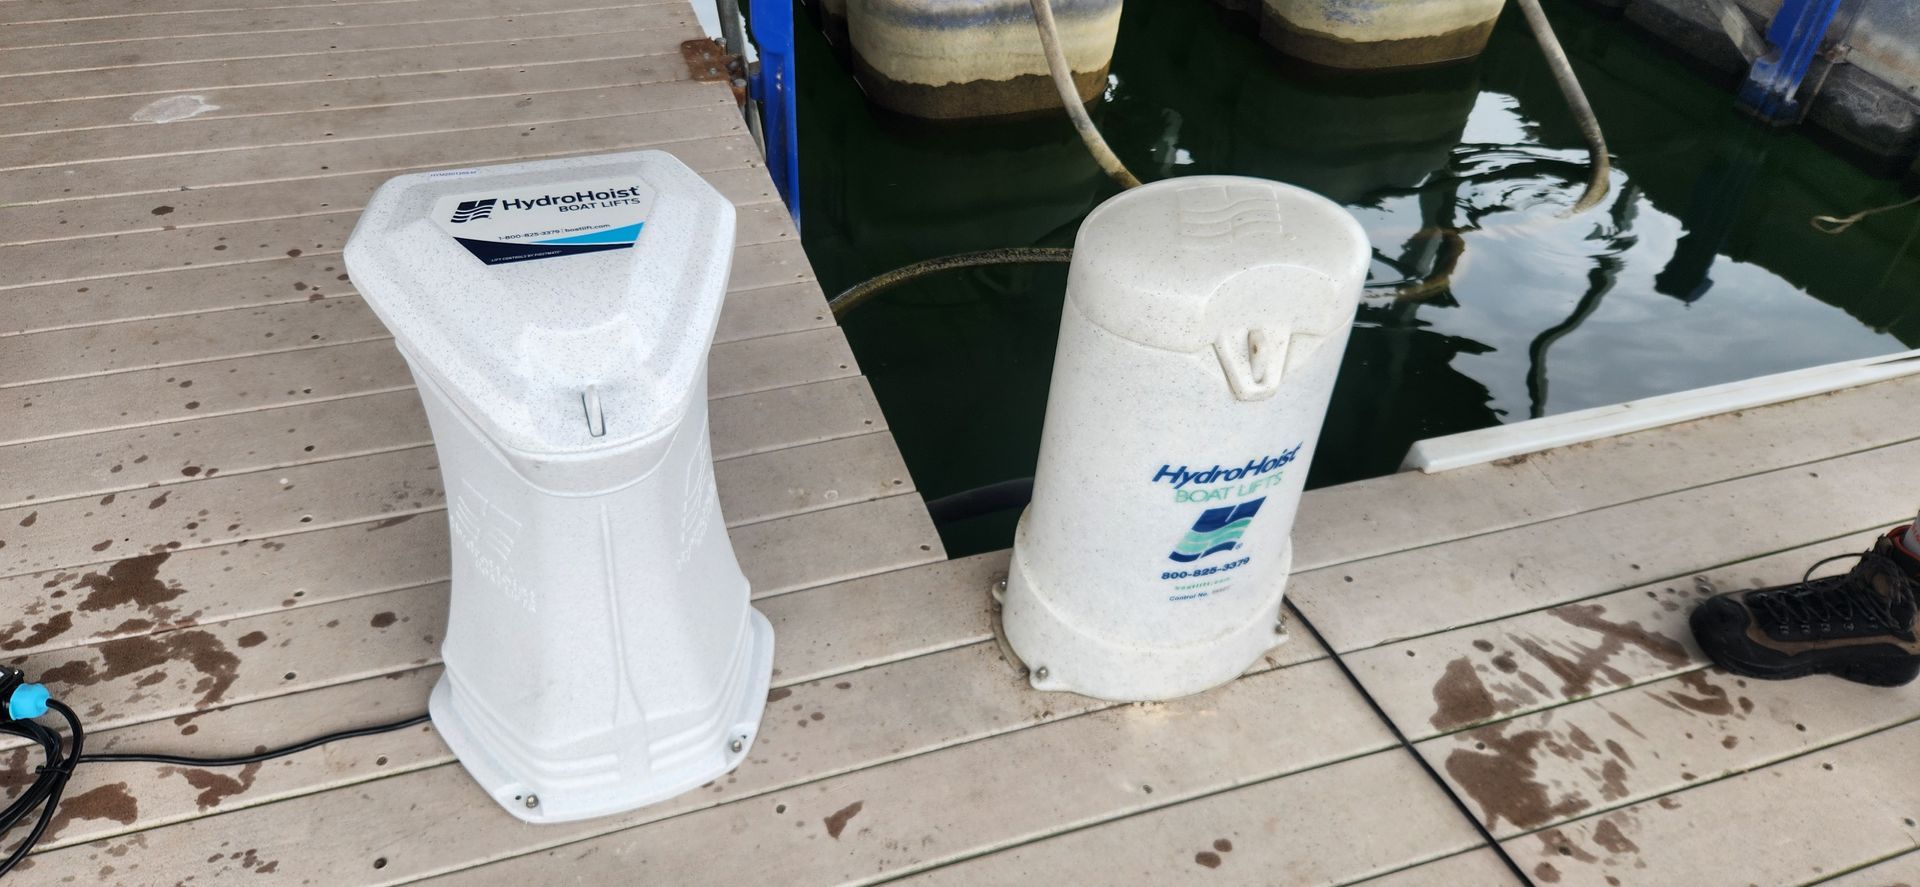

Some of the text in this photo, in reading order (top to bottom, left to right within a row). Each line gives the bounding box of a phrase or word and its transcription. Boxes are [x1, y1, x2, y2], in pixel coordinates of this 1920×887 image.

[502, 186, 640, 211] HydroHoist
[559, 198, 641, 213] BOAT LIFTS
[1152, 441, 1303, 490] HydroHoist
[1174, 471, 1284, 504] BOAT LIFTS
[1161, 556, 1250, 580] 800-825-3379
[1168, 593, 1196, 602] Control
